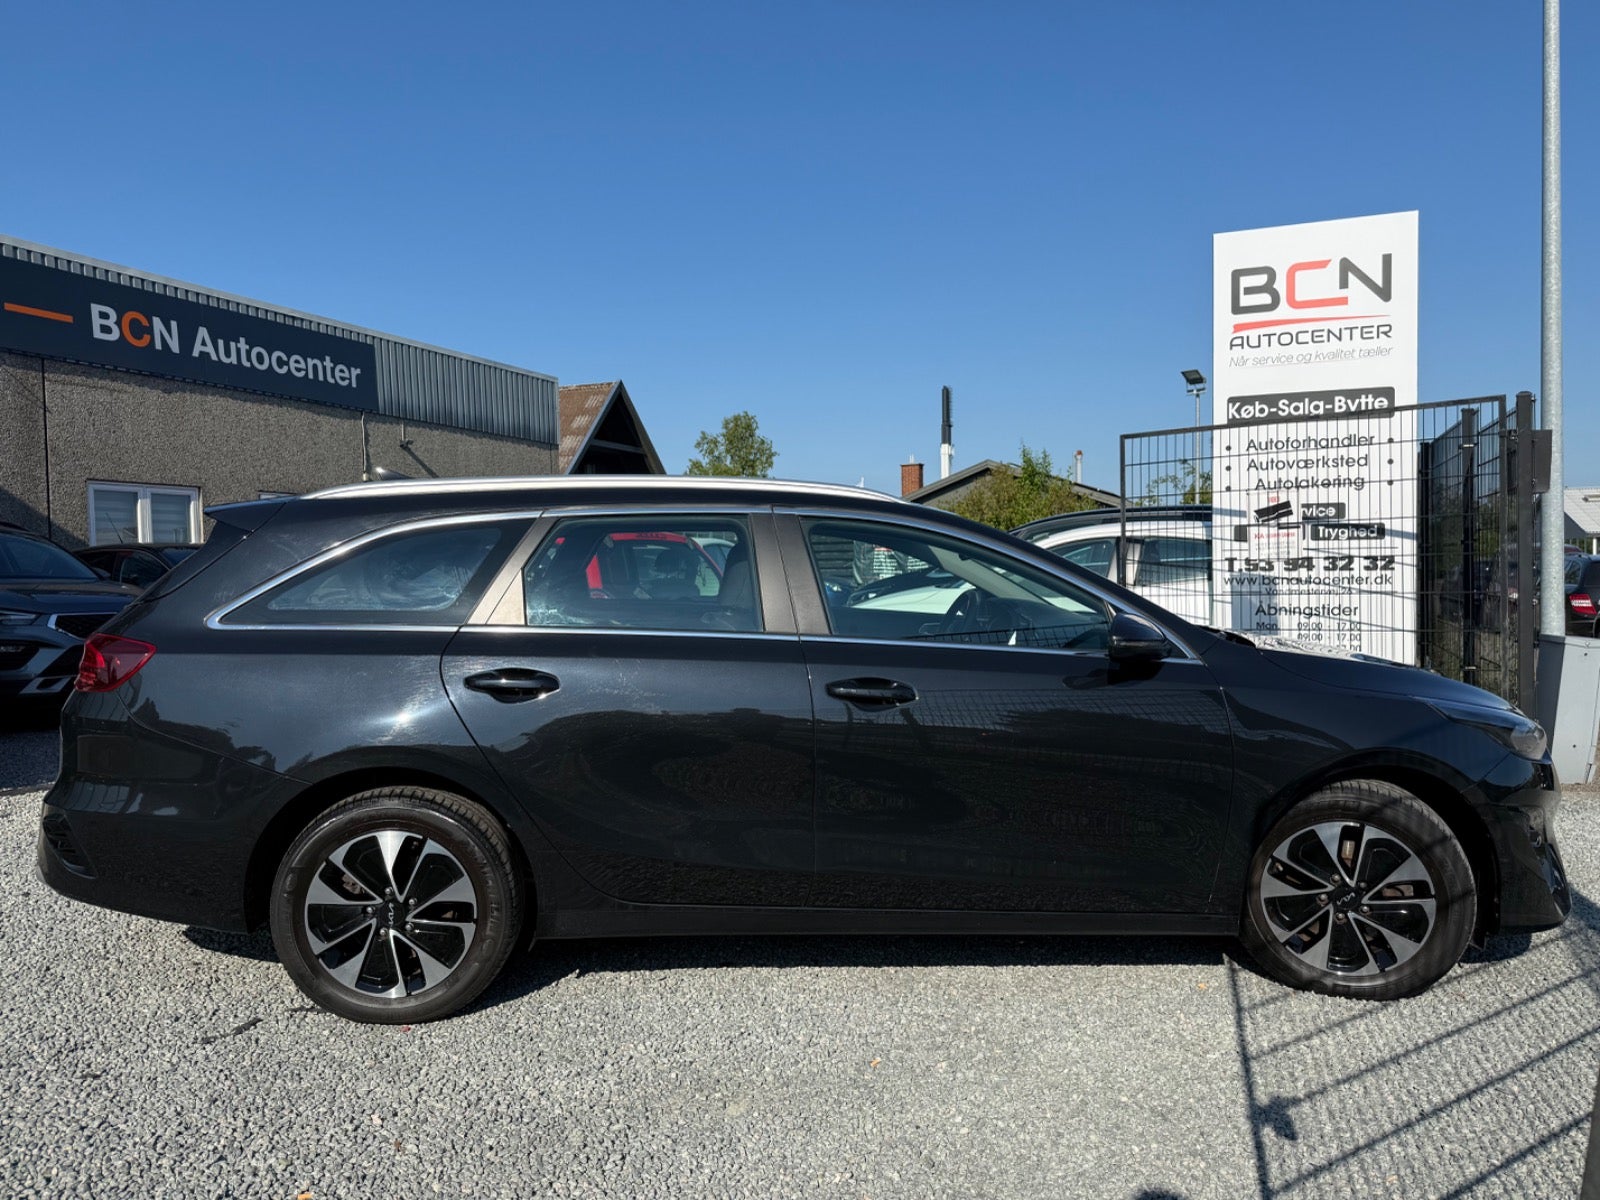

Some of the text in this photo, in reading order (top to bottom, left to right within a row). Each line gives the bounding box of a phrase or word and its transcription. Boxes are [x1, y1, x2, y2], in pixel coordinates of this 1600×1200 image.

[1230, 253, 1393, 316] BCN
[90, 303, 361, 388] BCN Autocenter
[1229, 323, 1393, 351] AUTOCENTER
[1229, 345, 1393, 368] Når service og kvalitet tæller
[1246, 434, 1375, 452] Autoforhandler
[1247, 454, 1368, 472] Autoværksted
[1255, 475, 1365, 491] Autolakering
[1318, 524, 1378, 540] Tryghed
[1283, 557, 1315, 572] 94
[1323, 556, 1355, 571] 32
[1363, 555, 1396, 571] 32
[1224, 574, 1393, 586] www.bcnautocenter.dk
[1255, 602, 1359, 618] Åbningstider
